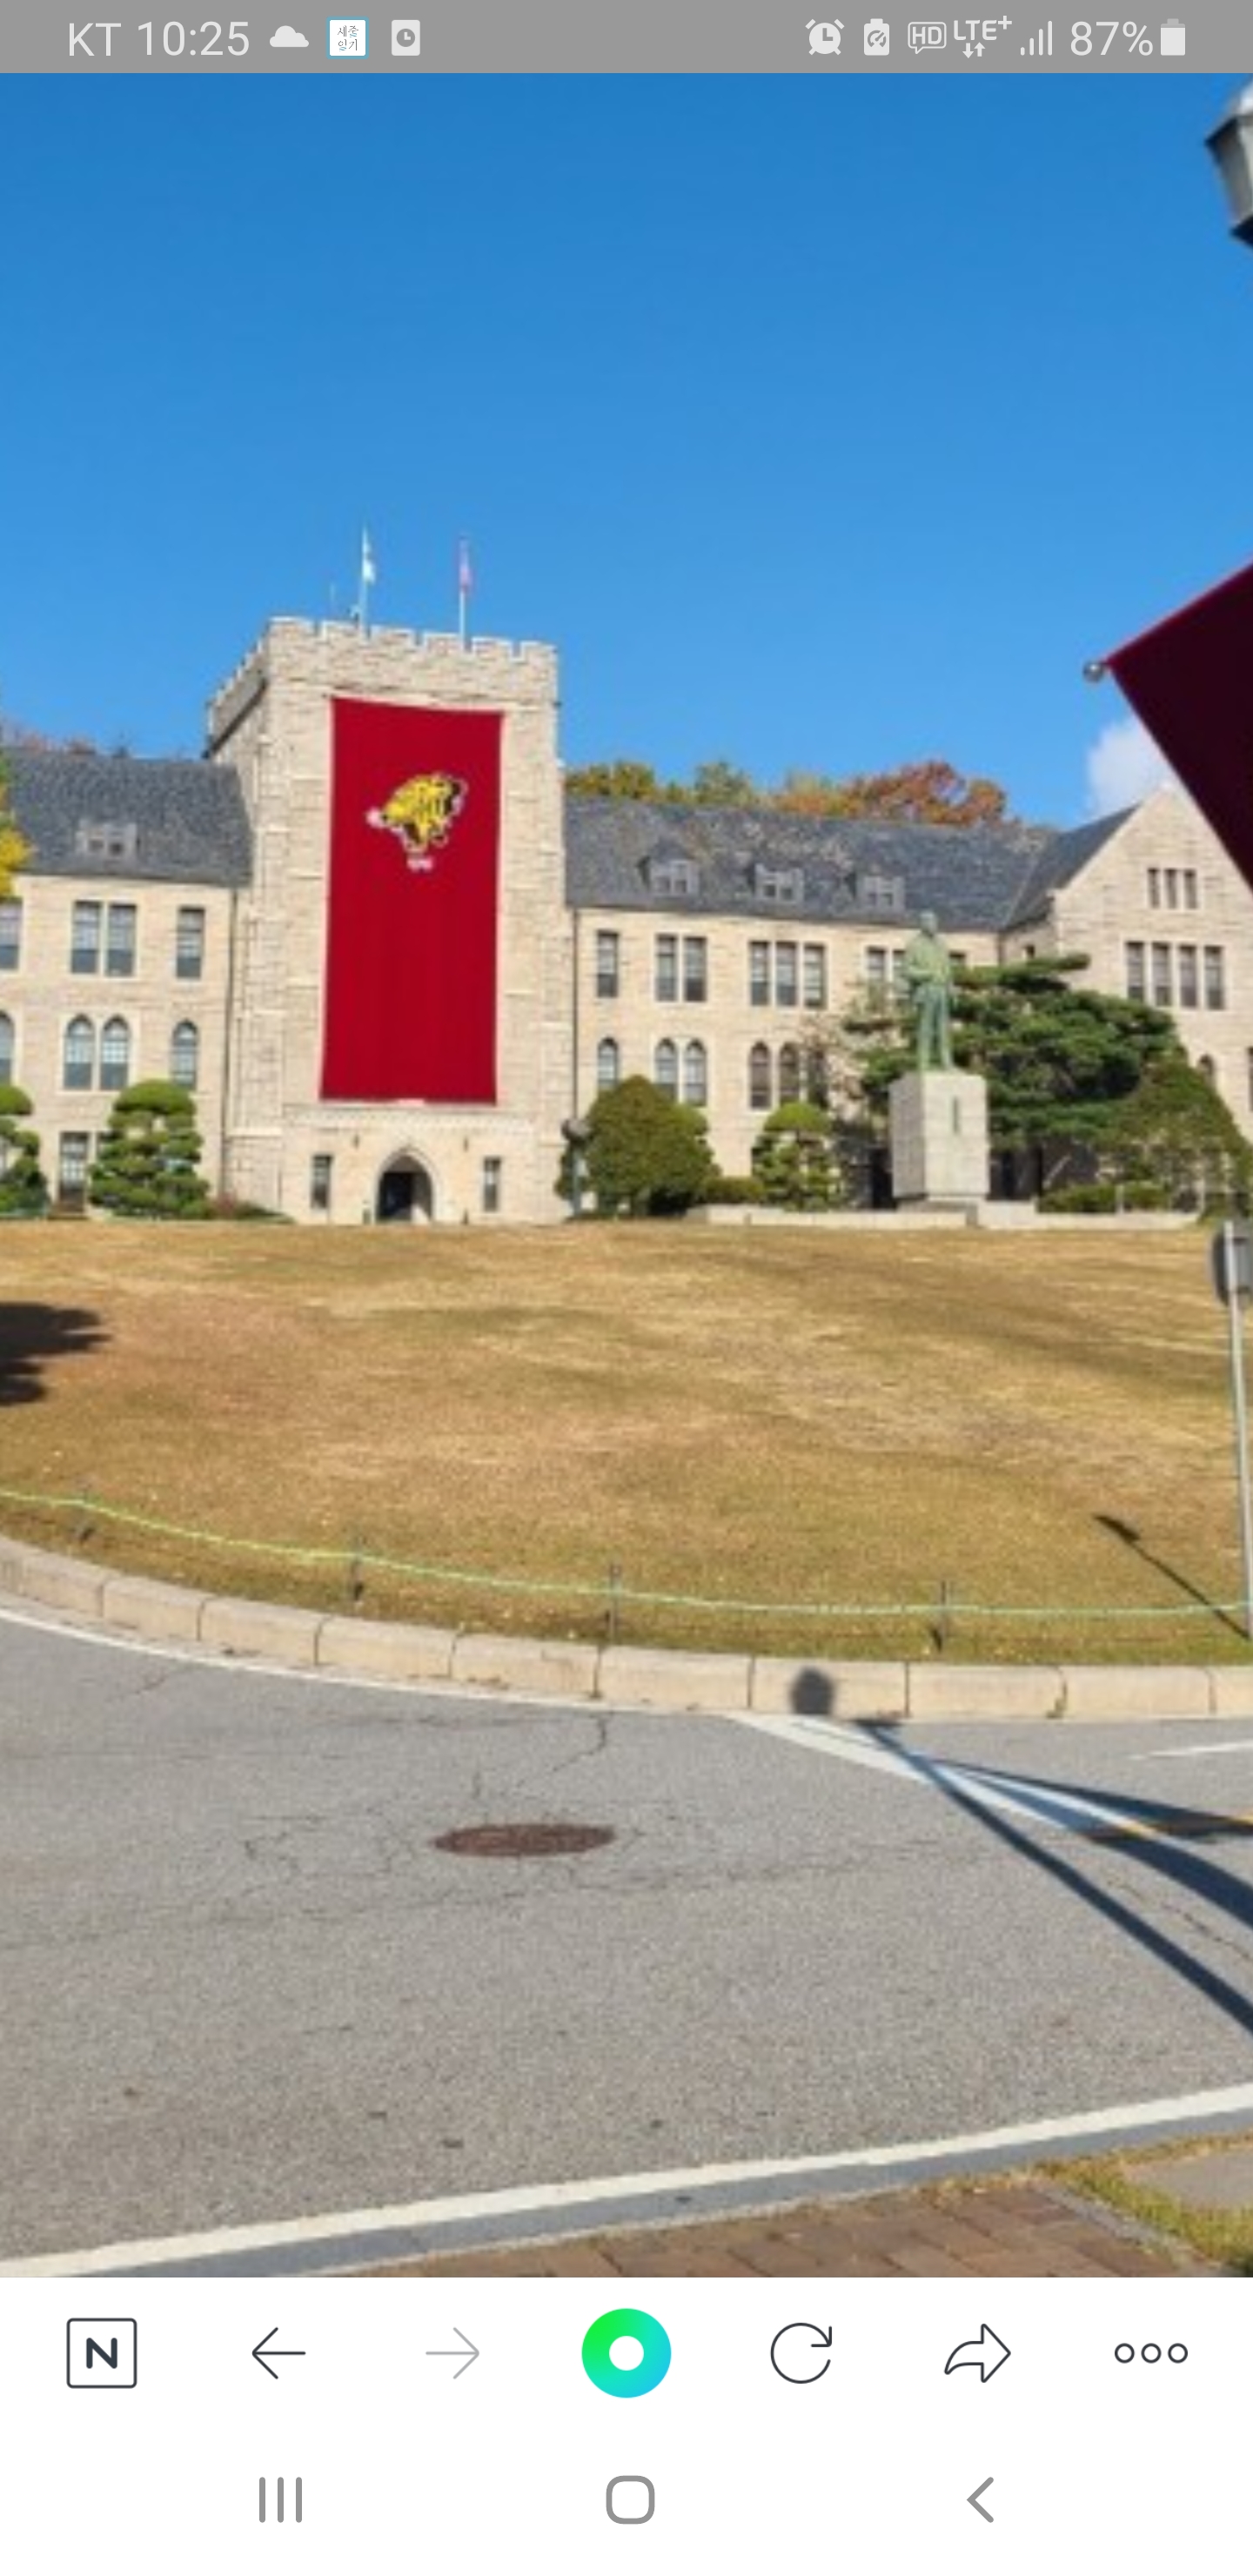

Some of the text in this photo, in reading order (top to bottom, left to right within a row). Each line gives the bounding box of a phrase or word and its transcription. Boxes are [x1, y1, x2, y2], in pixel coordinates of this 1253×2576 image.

[70, 21, 250, 57] KT 10:25
[912, 25, 942, 45] HD
[1070, 21, 1154, 57] 87%
[85, 2337, 118, 2370] N
